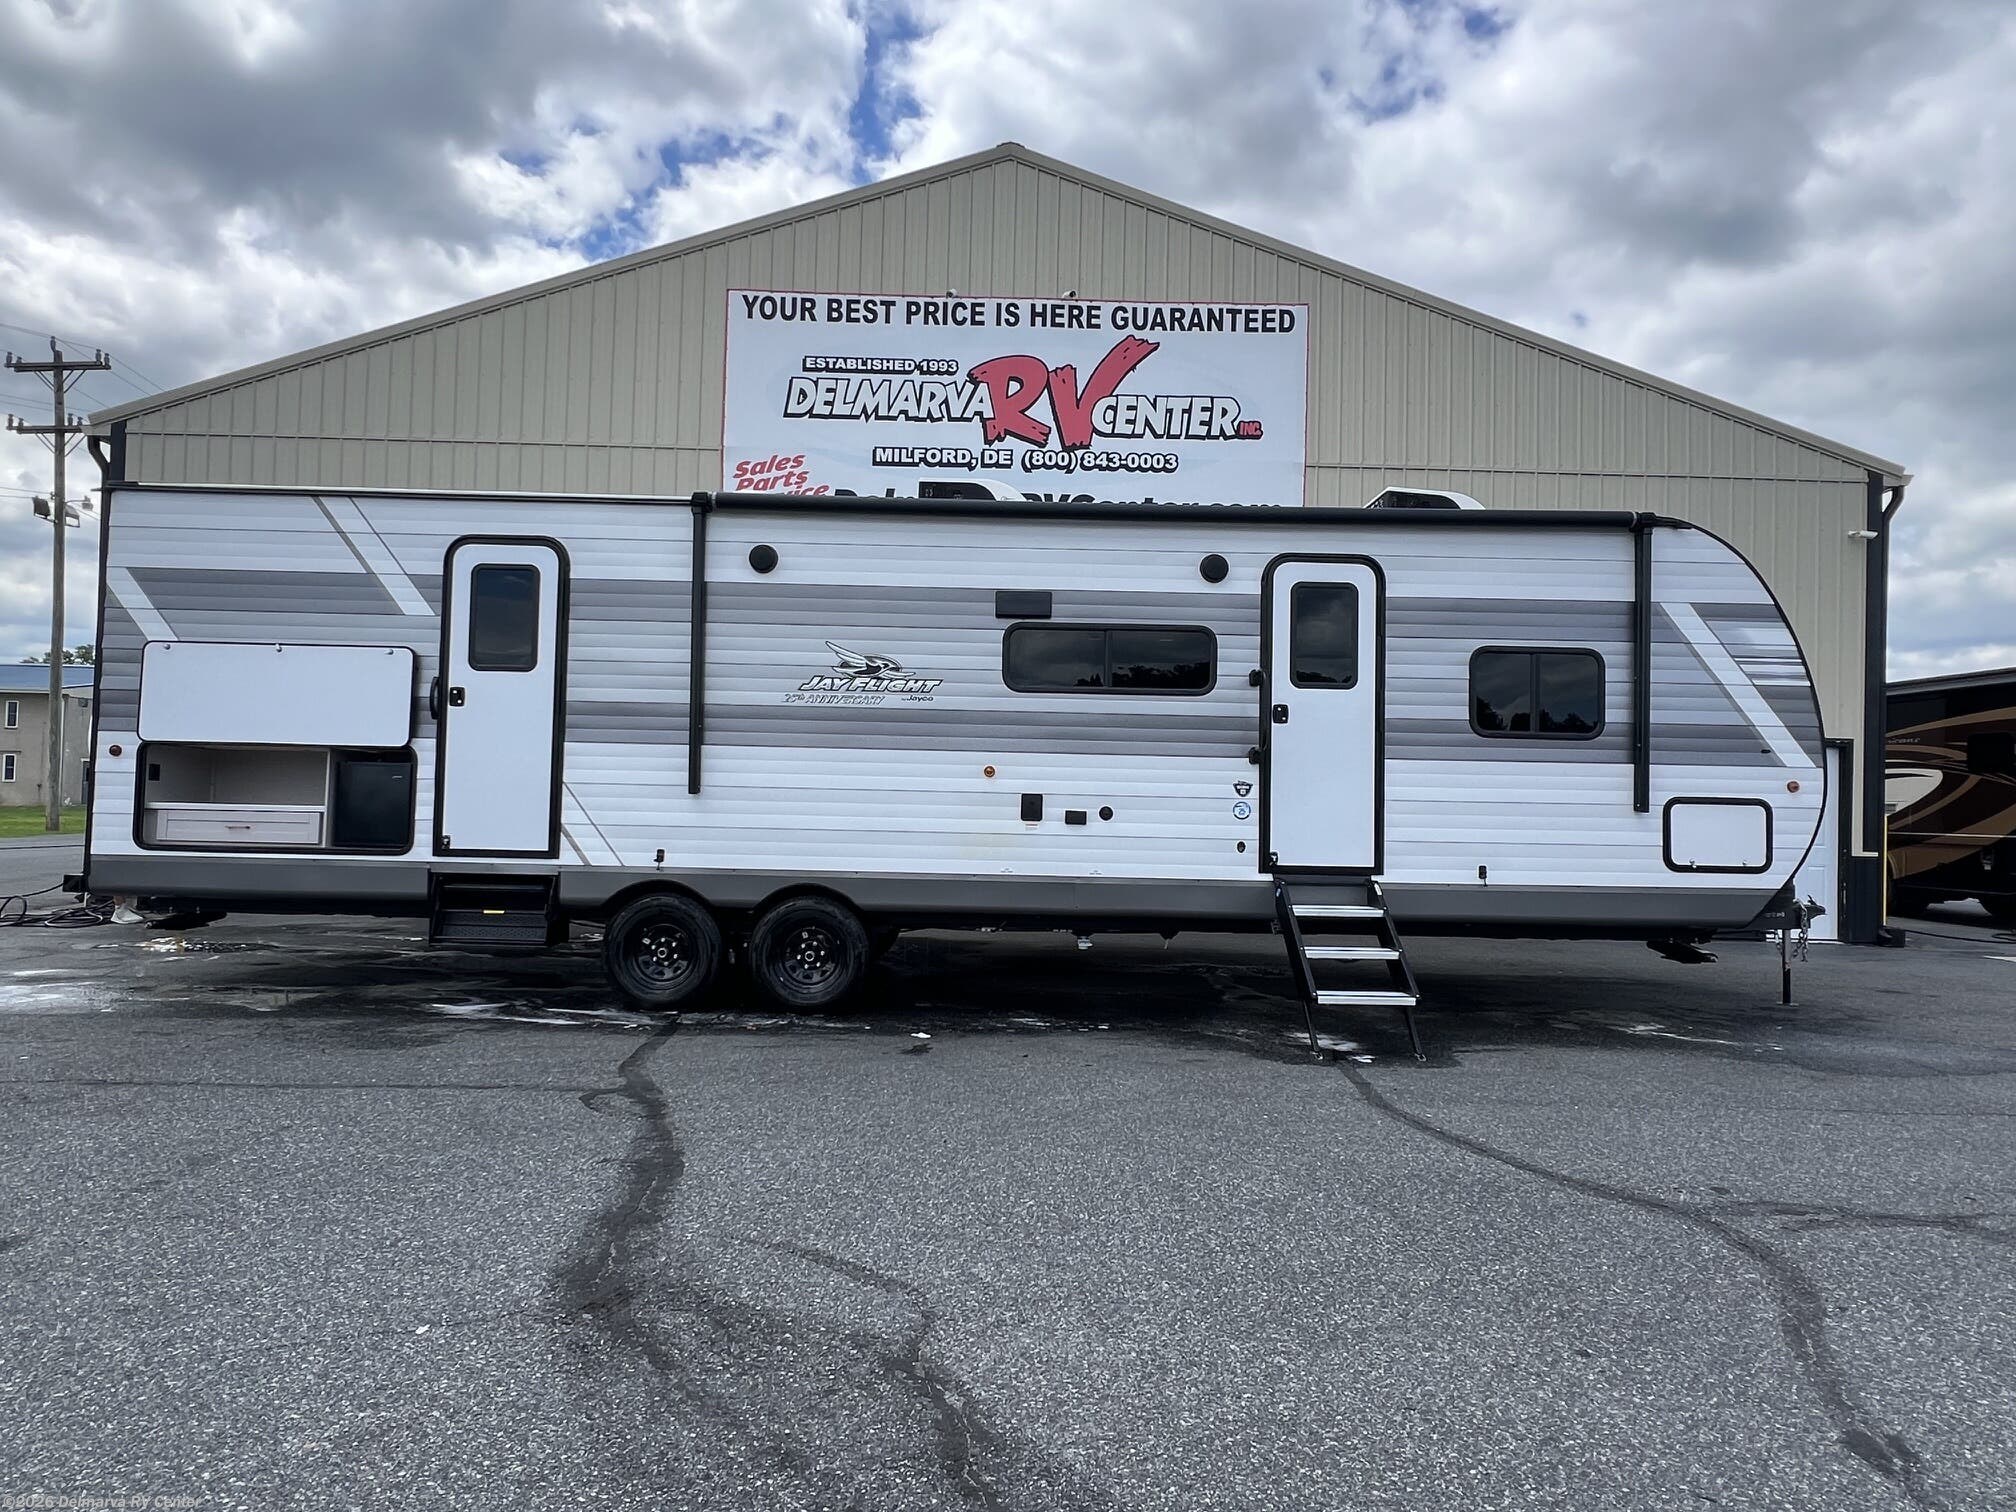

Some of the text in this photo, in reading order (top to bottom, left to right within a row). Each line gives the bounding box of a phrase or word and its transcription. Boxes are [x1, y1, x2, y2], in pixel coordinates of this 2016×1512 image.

[742, 295, 1296, 333] YOUR BEST PRICE IS HERE GUARANTEED
[803, 356, 959, 375] ESTABLISHED 1993
[784, 377, 998, 422] DELMARVA
[967, 334, 1160, 450] RV
[1091, 395, 1241, 440] CENTER
[733, 454, 806, 479] Sales
[873, 447, 1179, 473] MILFORD, DE (800) 843-0003
[736, 470, 810, 491] Parts
[799, 675, 943, 693] JAY FLIGHT
